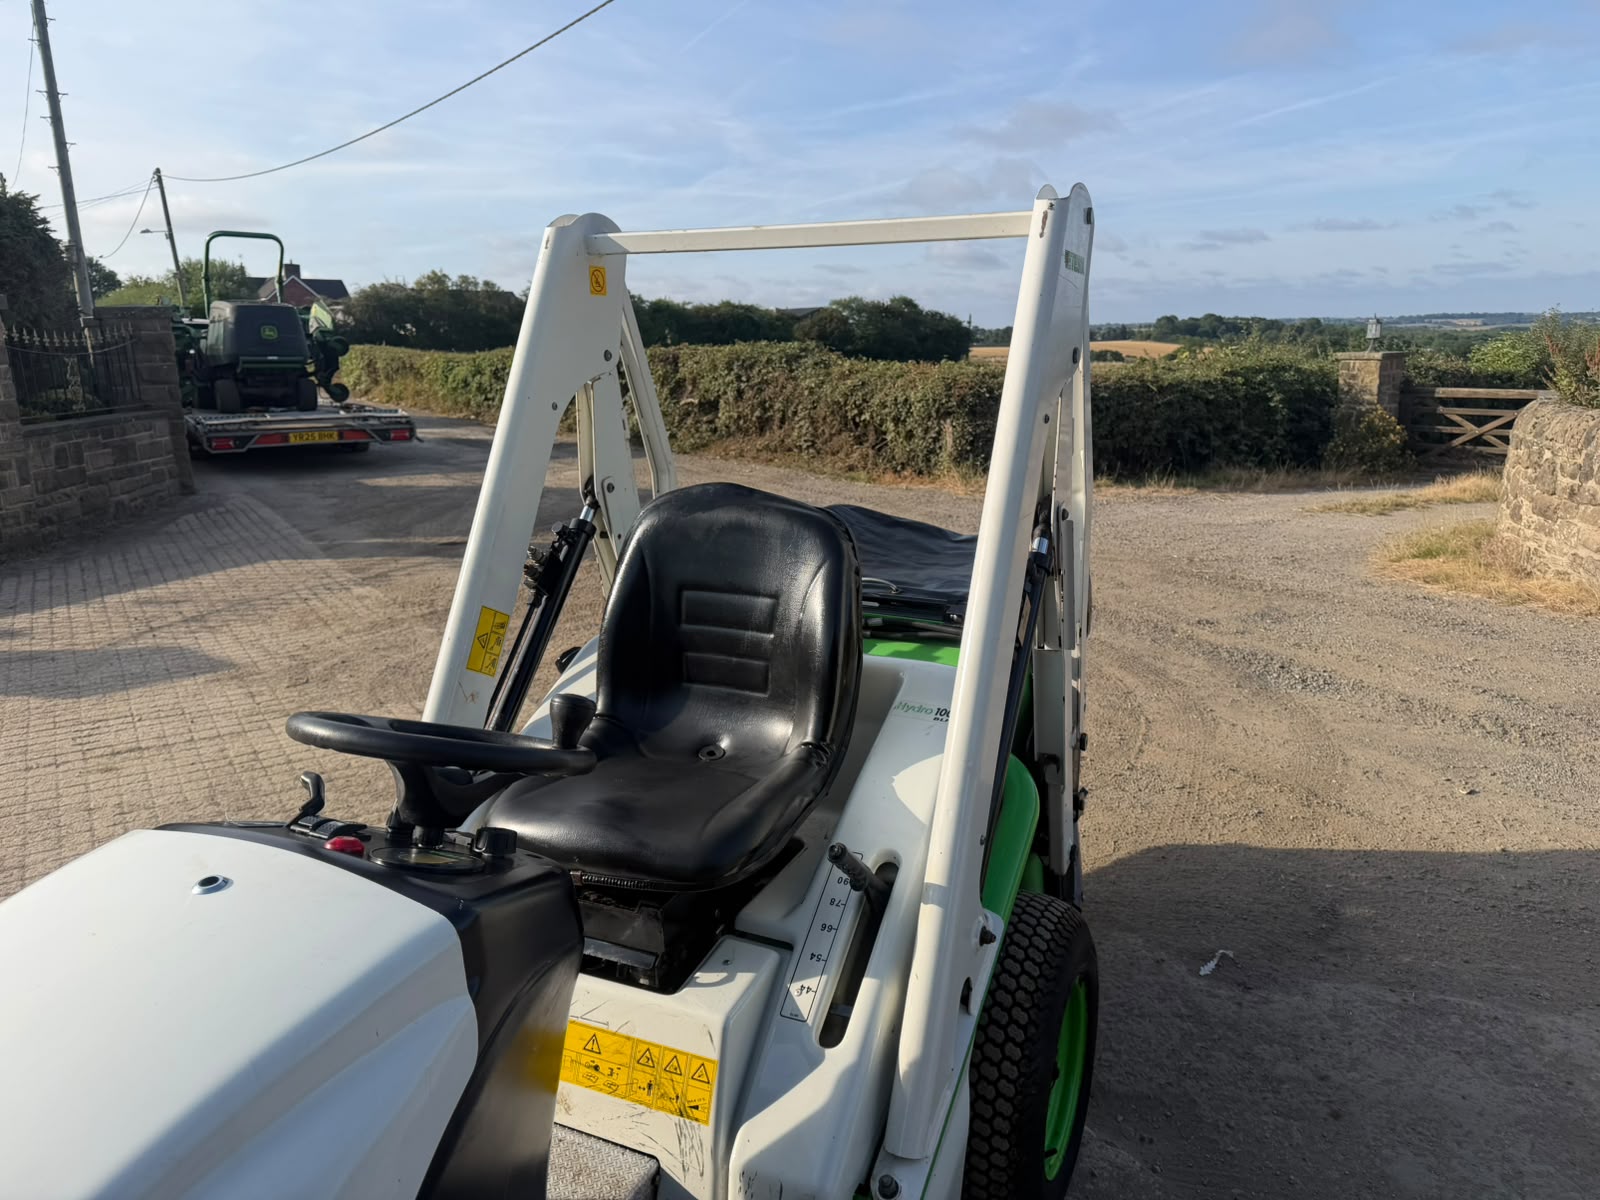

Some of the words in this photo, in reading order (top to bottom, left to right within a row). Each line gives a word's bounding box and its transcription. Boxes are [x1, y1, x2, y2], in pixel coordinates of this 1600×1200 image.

[837, 876, 849, 886] 90
[830, 897, 841, 907] 78
[820, 923, 833, 933] 66
[809, 952, 823, 963] 54
[800, 983, 812, 994] 44
